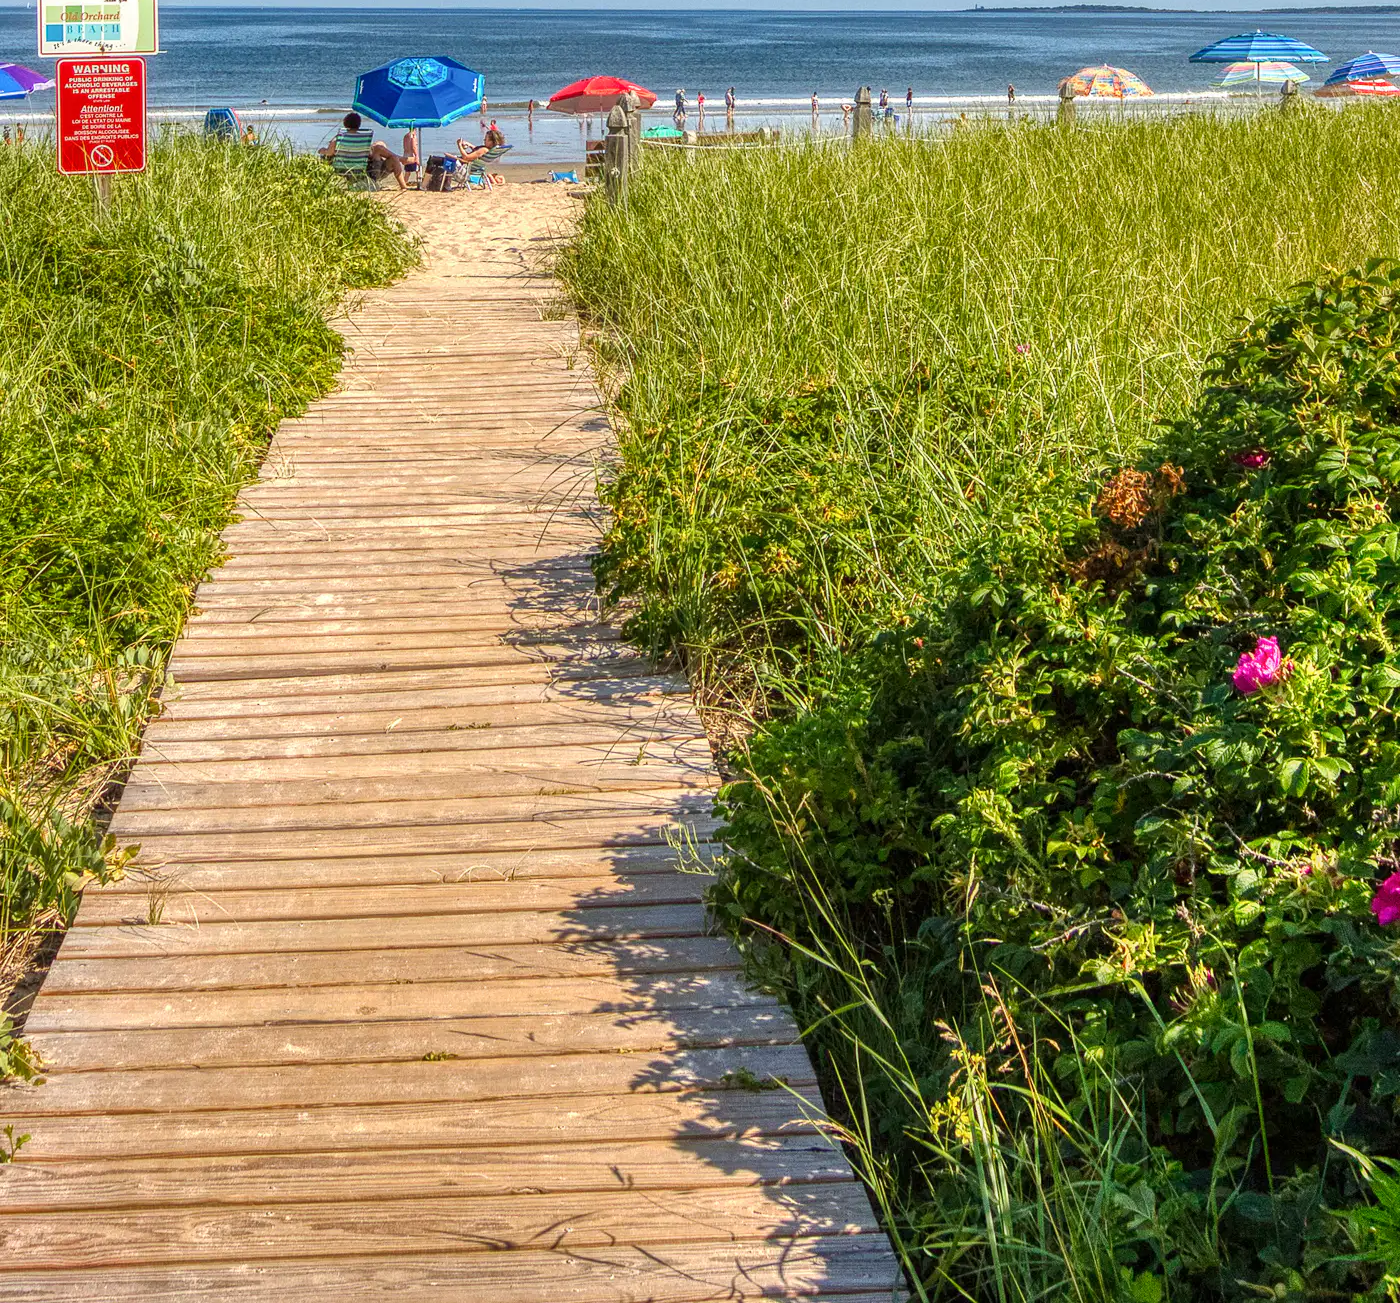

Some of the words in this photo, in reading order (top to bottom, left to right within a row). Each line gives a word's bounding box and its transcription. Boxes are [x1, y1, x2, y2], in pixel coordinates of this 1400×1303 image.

[61, 12, 78, 21] Old
[81, 11, 120, 20] Orchard
[67, 24, 119, 33] BEACH
[73, 64, 130, 74] WARNING
[80, 104, 123, 113] Attention!
